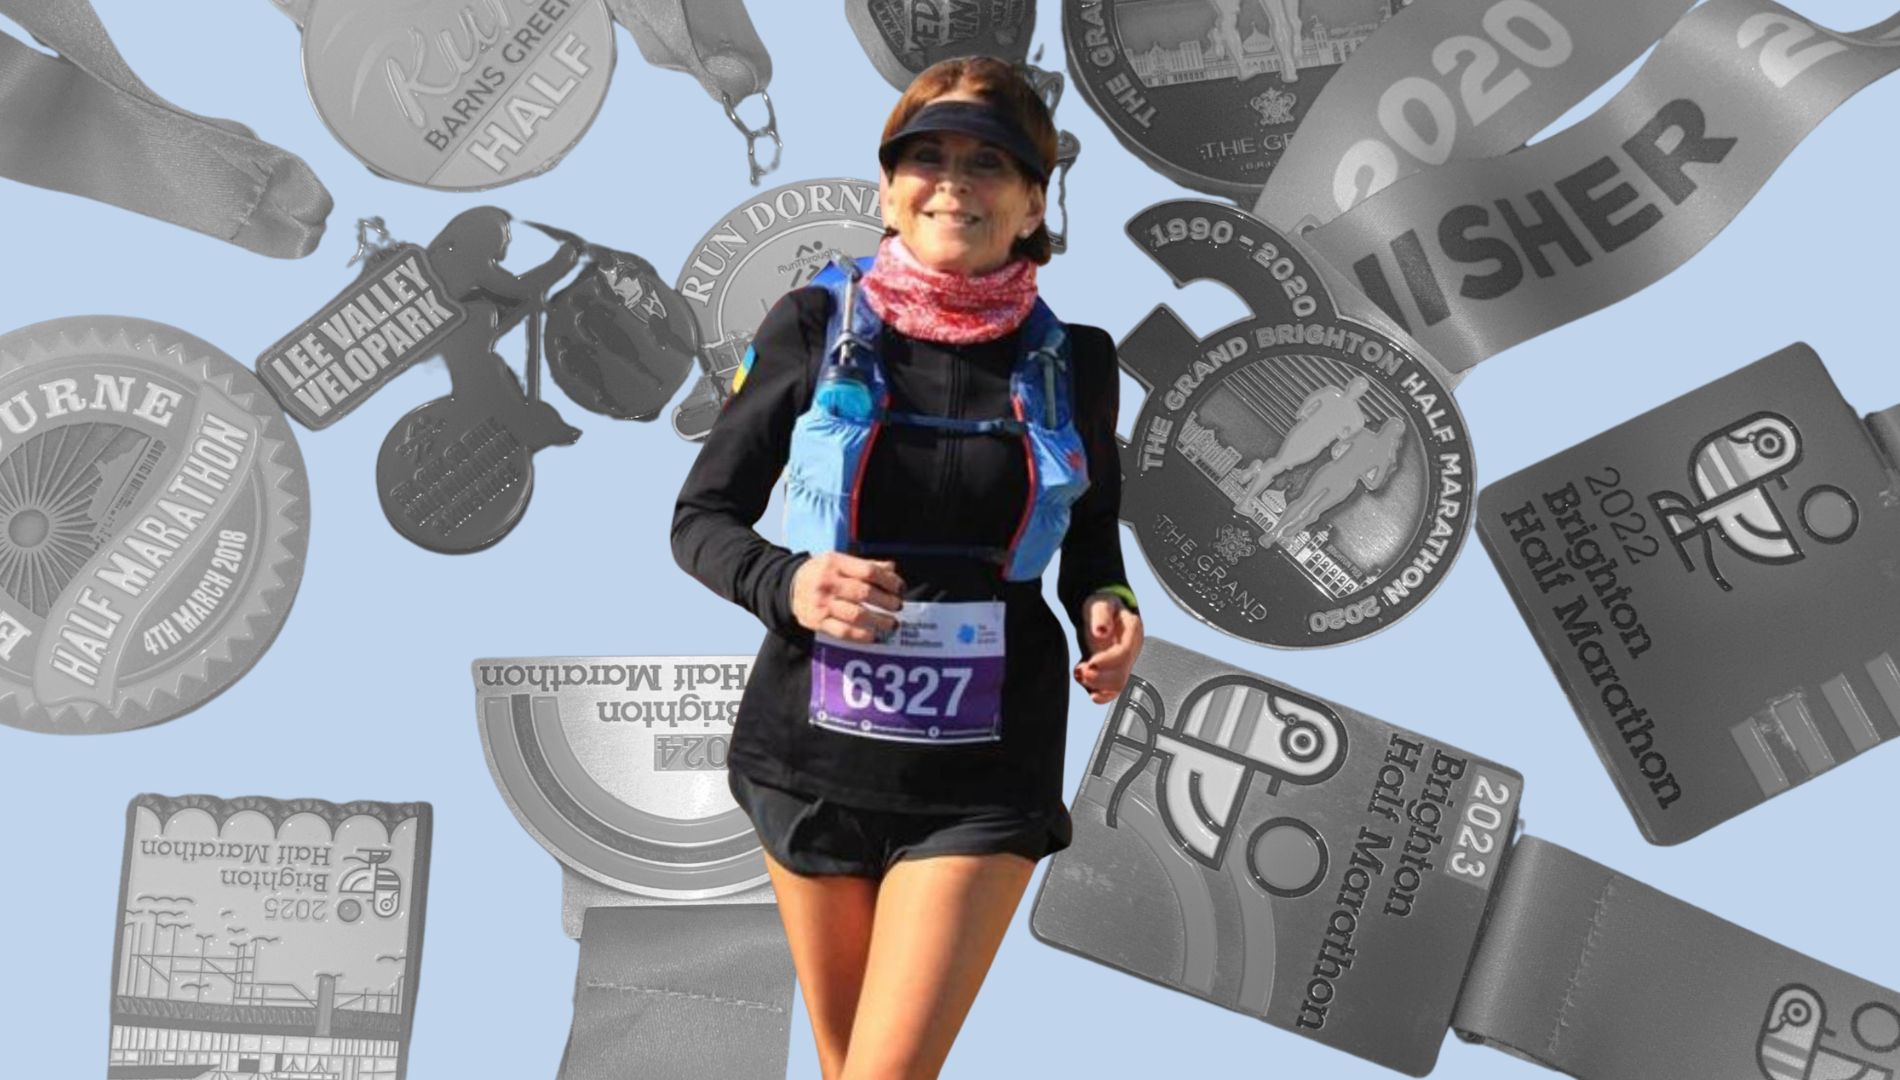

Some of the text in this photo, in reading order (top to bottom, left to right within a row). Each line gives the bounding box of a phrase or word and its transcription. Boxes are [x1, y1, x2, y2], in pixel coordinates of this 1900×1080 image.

[424, 0, 570, 151] BARNS GREE
[467, 32, 593, 174] HALF
[1104, 72, 1157, 129] THE
[1202, 136, 1257, 159] THE
[681, 221, 748, 307] RUN
[271, 256, 430, 390] LEE VALLEY
[294, 289, 454, 417] VELOPARK
[0, 374, 183, 435] URNE
[1142, 323, 1462, 633] THE GRAND BRIGHTON HALF MARATHON 2020
[1585, 466, 1660, 565] 2022
[51, 413, 249, 686] HALF MARATHON
[143, 529, 248, 656] 4TH MARCH 2018
[1157, 515, 1268, 621] THE GRAND
[1543, 482, 1652, 660] Brighton
[480, 663, 748, 692] Half Marathon
[842, 658, 974, 717] 6327
[1501, 501, 1683, 810] Half Marathon
[140, 839, 331, 866] Half Marathon
[1383, 749, 1468, 918] Brighton
[1451, 774, 1509, 879] 2023
[220, 868, 328, 893] Brighton
[264, 898, 327, 921] 2025
[1297, 733, 1424, 1031] Half Marathon
